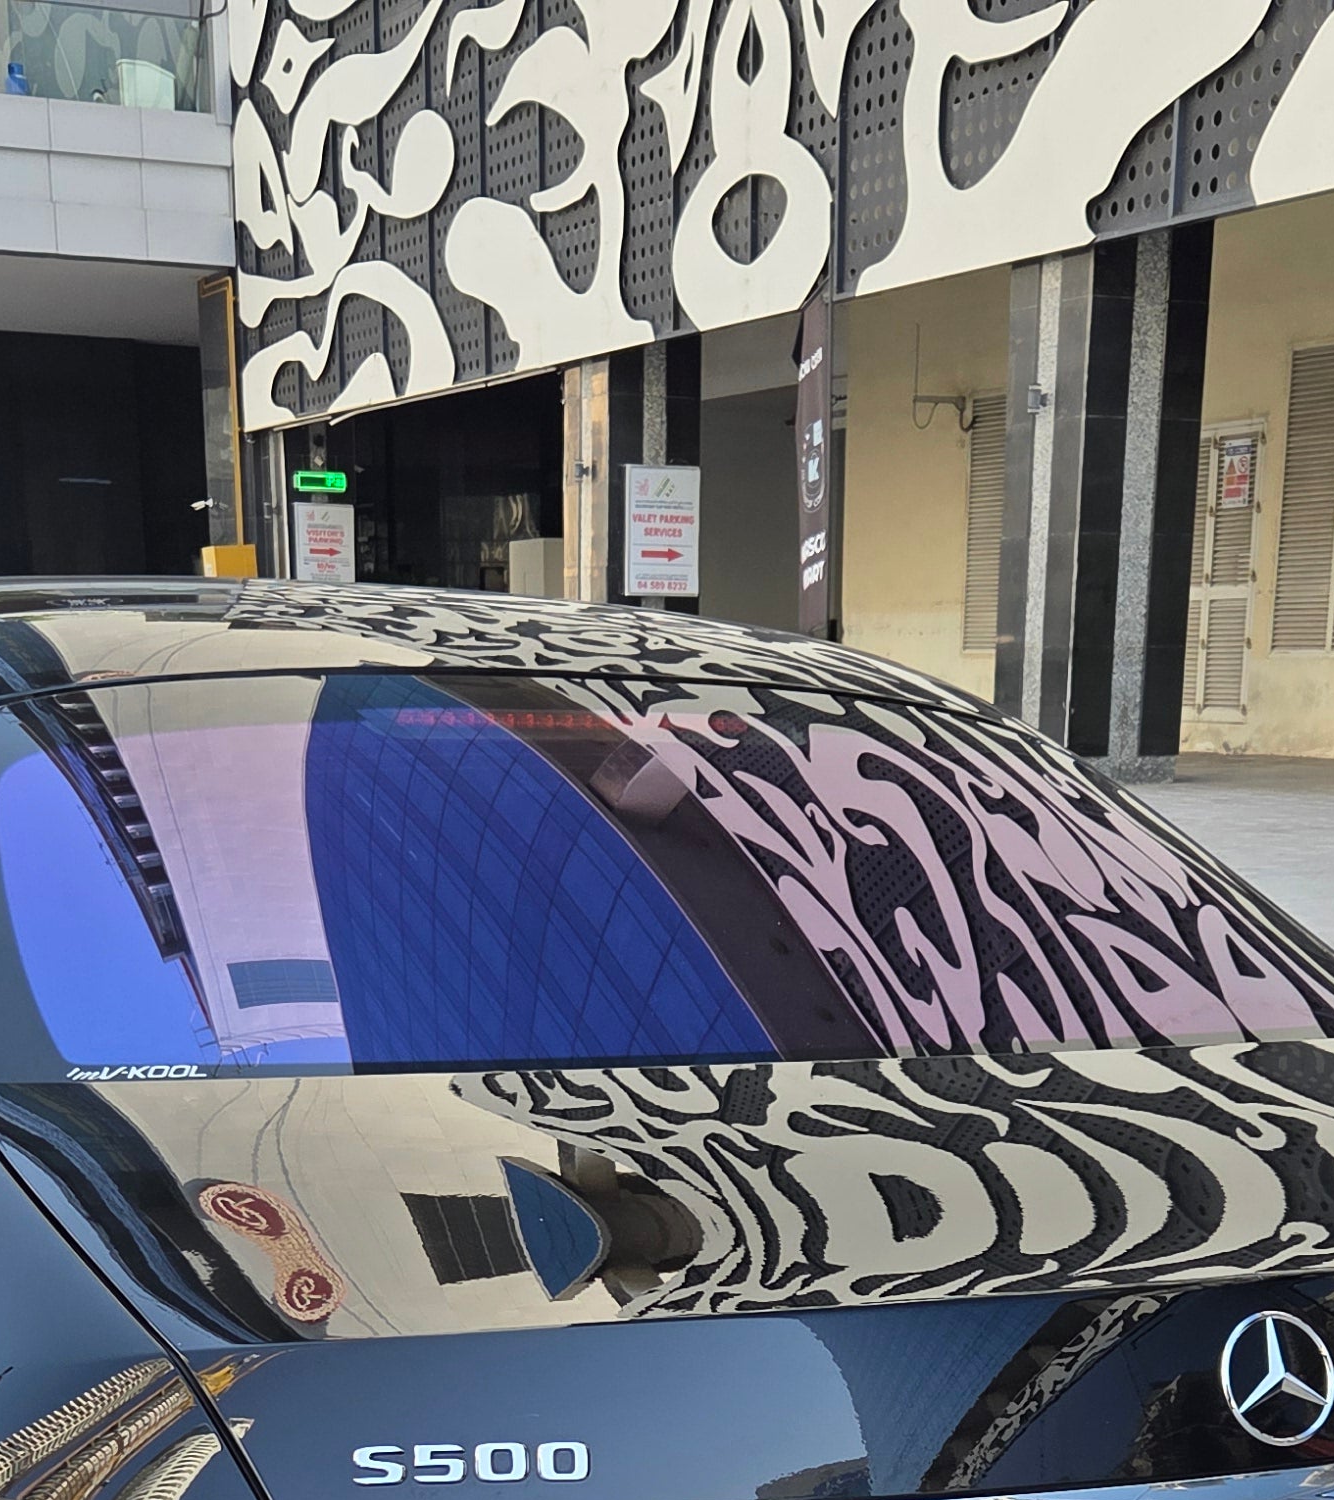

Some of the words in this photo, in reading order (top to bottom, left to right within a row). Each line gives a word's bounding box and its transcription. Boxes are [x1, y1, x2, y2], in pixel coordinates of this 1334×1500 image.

[632, 513, 658, 524] VALET
[659, 514, 695, 526] PARKING
[644, 527, 683, 538] SERVICES
[352, 1441, 591, 1486] S500
